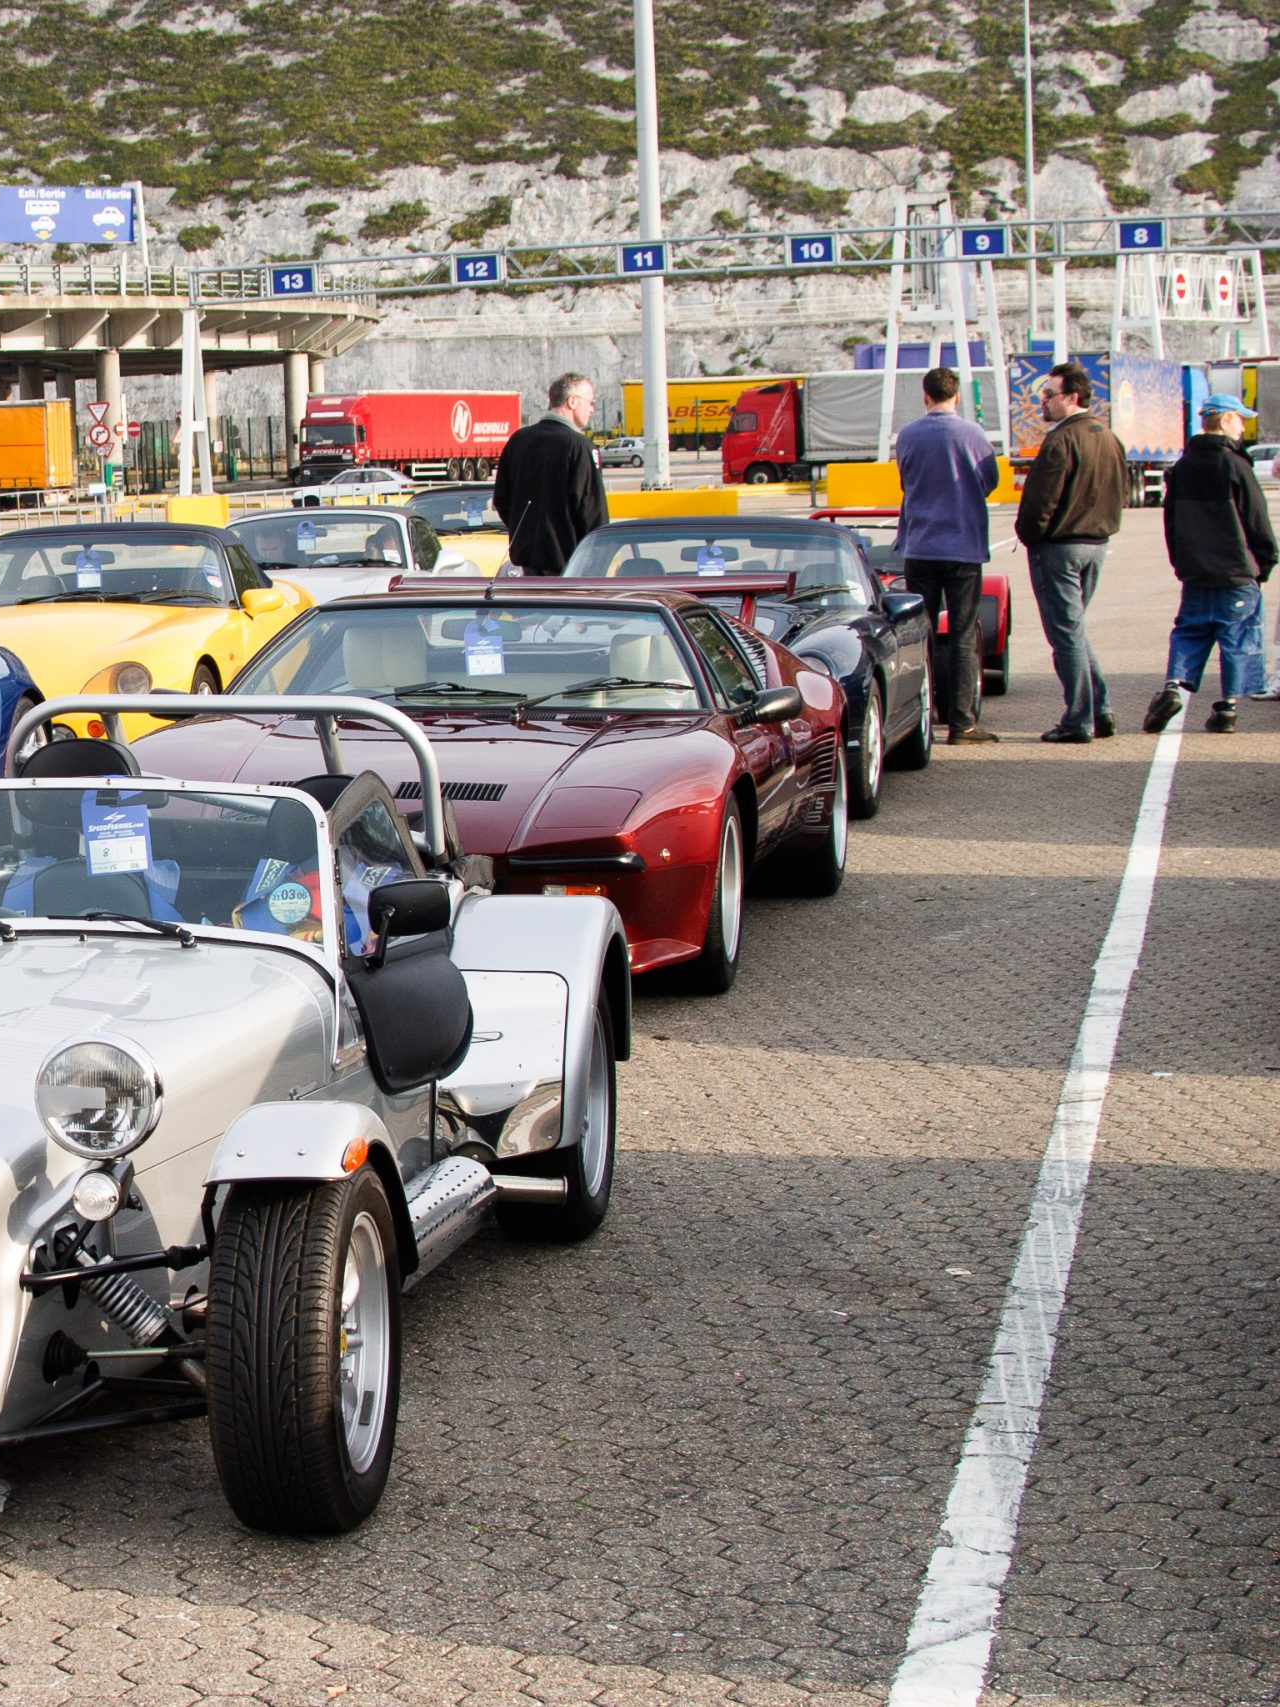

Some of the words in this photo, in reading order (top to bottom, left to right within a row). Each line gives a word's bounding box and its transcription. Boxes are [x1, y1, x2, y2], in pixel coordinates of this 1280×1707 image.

[975, 235, 991, 251] 9
[1133, 228, 1150, 245] 8
[799, 242, 825, 259] 10
[632, 252, 654, 267] 11
[464, 262, 489, 278] 12
[280, 274, 304, 290] 13
[472, 422, 510, 434] NICHOLLS
[281, 888, 297, 901] 03
